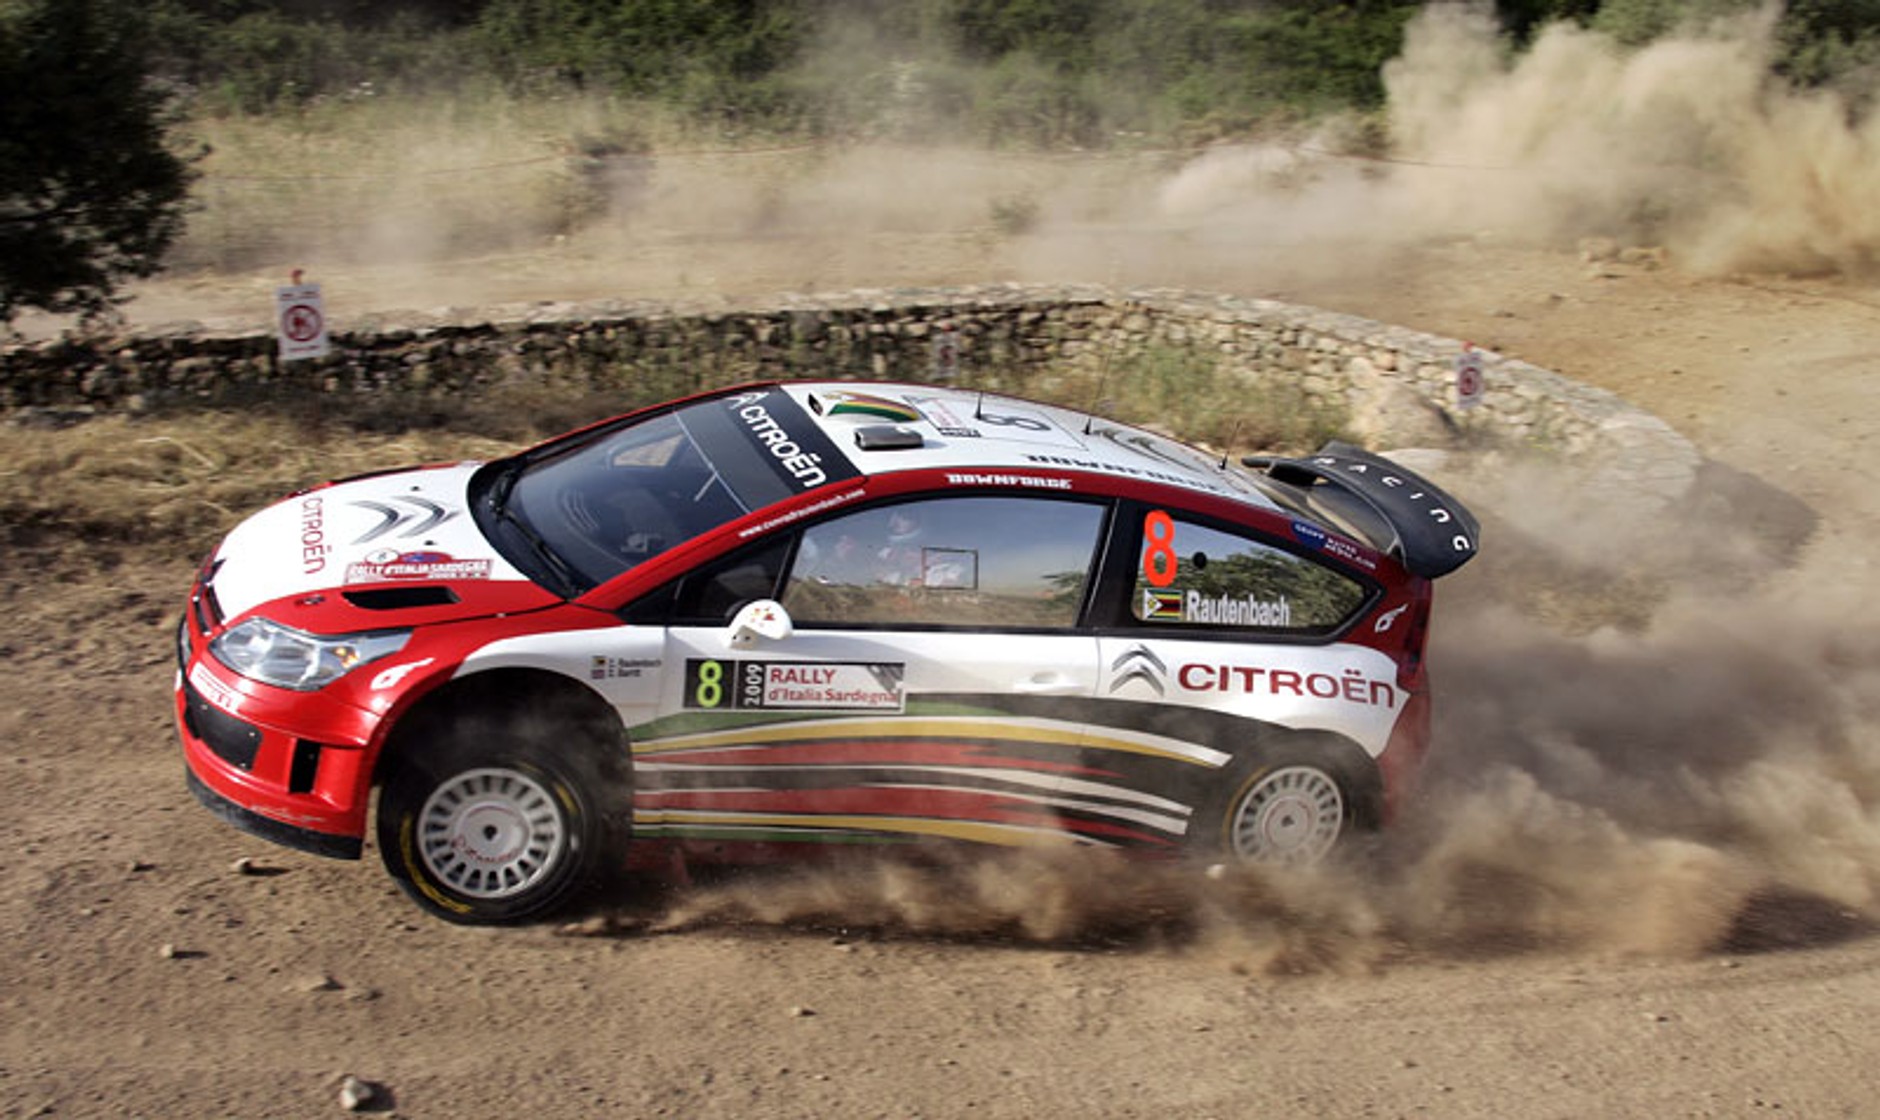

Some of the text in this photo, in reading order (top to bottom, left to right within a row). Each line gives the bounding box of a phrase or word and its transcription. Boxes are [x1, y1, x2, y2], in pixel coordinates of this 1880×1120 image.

[1143, 509, 1178, 587] 8
[1186, 588, 1291, 627] Rautenbach
[697, 660, 724, 708] 8
[744, 664, 764, 707] 2009
[769, 666, 837, 684] RALLY
[1177, 663, 1395, 708] CITROËN
[769, 688, 899, 706] d'Italia Sardegna
